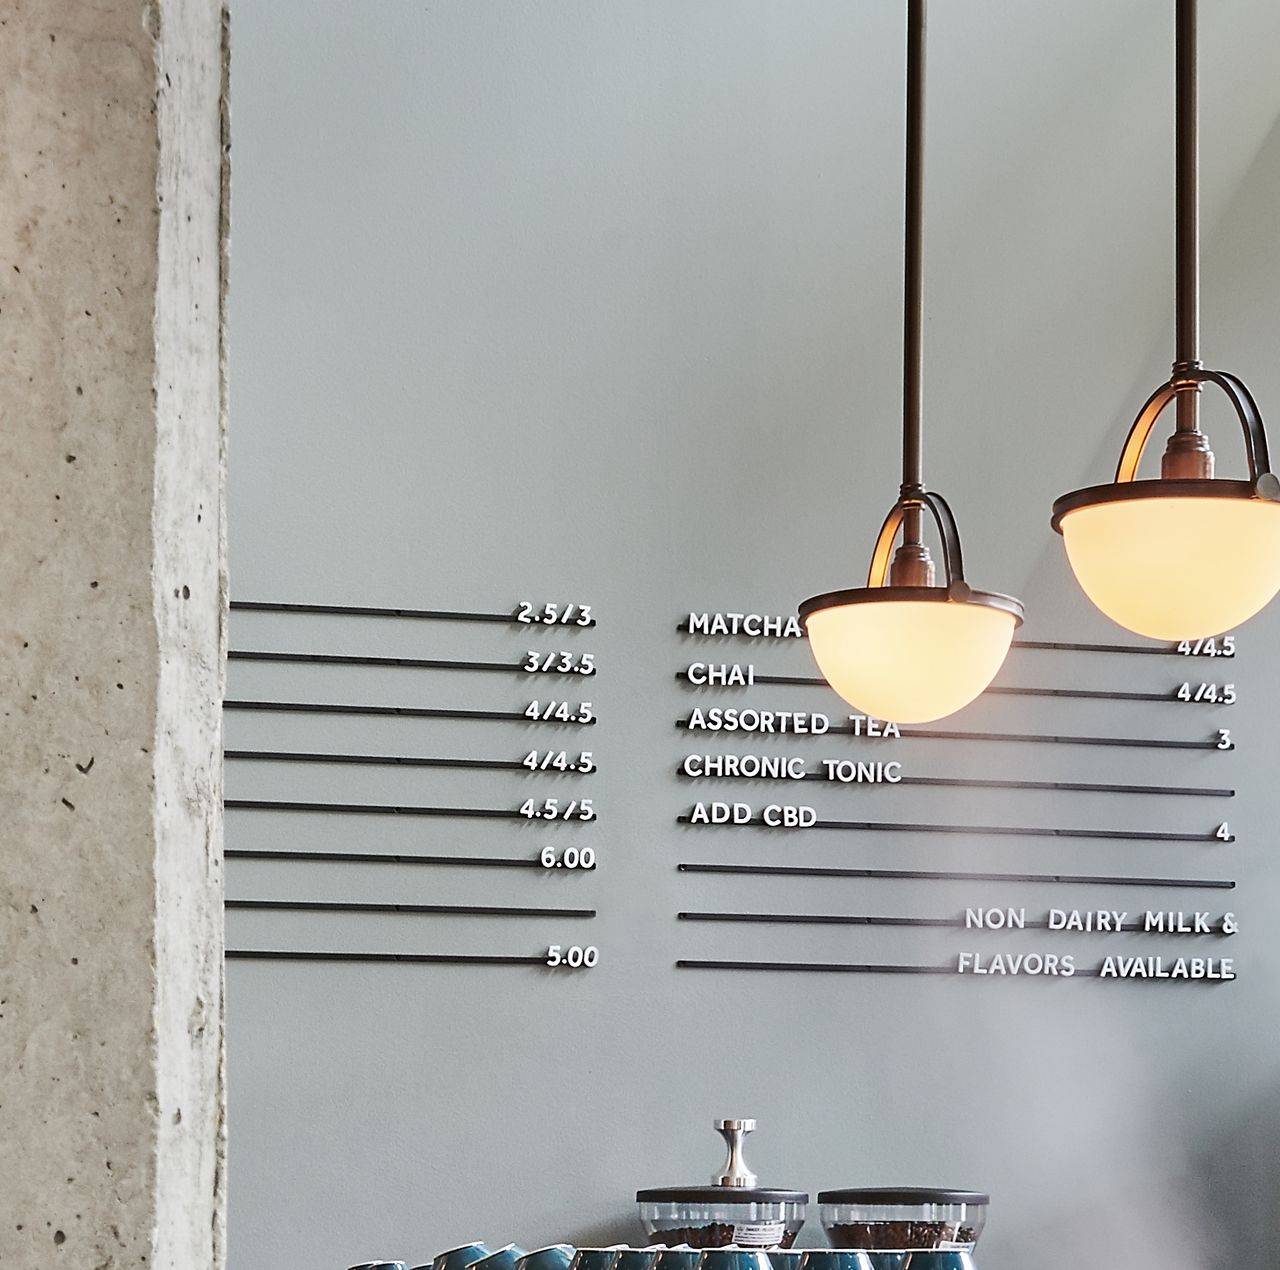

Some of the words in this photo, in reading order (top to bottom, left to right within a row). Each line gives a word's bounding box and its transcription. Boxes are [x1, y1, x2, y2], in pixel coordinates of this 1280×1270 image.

[517, 601, 592, 626] 2.5/3
[689, 612, 802, 638] MATCHA
[1177, 635, 1236, 657] 4/4.5
[523, 650, 595, 675] 3/3.5
[687, 662, 755, 686] CHAI
[1177, 682, 1237, 705] 4/4.5
[524, 700, 593, 724] 4/4.5
[688, 707, 831, 736] ASSORTED
[848, 714, 901, 739] TEA
[1216, 728, 1232, 750] 3
[522, 750, 593, 773] 4/4.5
[683, 754, 806, 780] CHRONIC
[822, 759, 903, 784] TONIC
[519, 797, 594, 821] 4.5/5
[690, 802, 753, 824] ADD
[762, 804, 818, 828] CBD
[1216, 821, 1231, 841] 4
[540, 846, 596, 869] 6.00
[964, 907, 1026, 930] NON
[1047, 908, 1129, 933] DAIRY
[1143, 910, 1211, 934] MILK
[1222, 911, 1240, 935] &
[546, 945, 600, 968] 5.00
[957, 951, 1076, 977] FLAVORS
[1099, 955, 1237, 980] AVAILABLE
